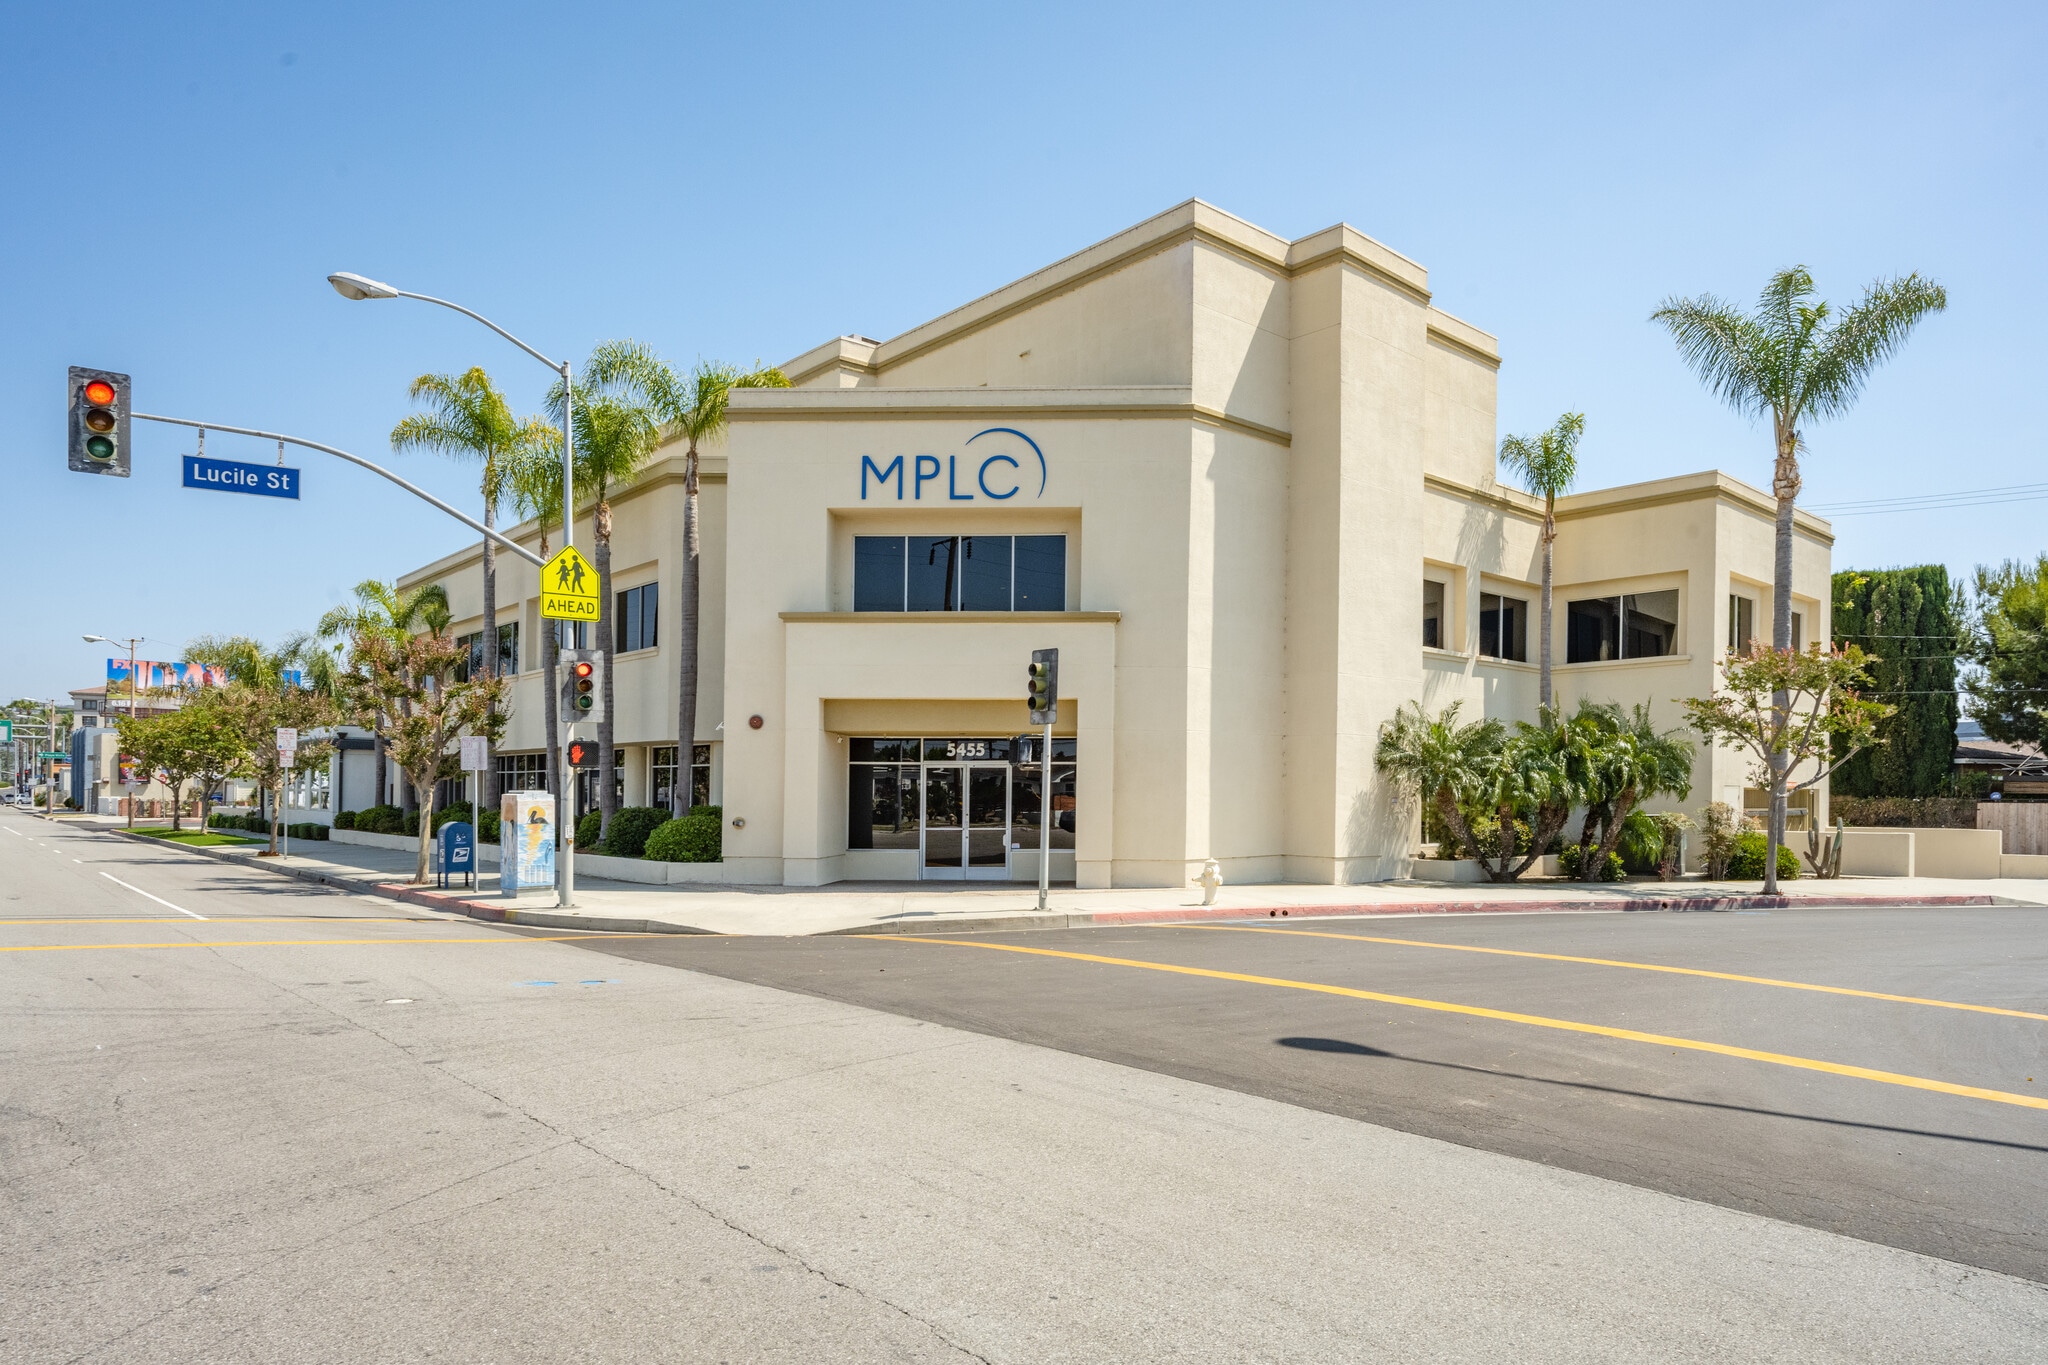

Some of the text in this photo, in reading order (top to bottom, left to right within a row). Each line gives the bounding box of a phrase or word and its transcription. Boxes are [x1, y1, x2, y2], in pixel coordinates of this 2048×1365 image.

[193, 463, 290, 490] Lucile St
[861, 455, 1019, 500] MPLC
[547, 599, 595, 614] AHEAD
[946, 742, 985, 757] 5455
